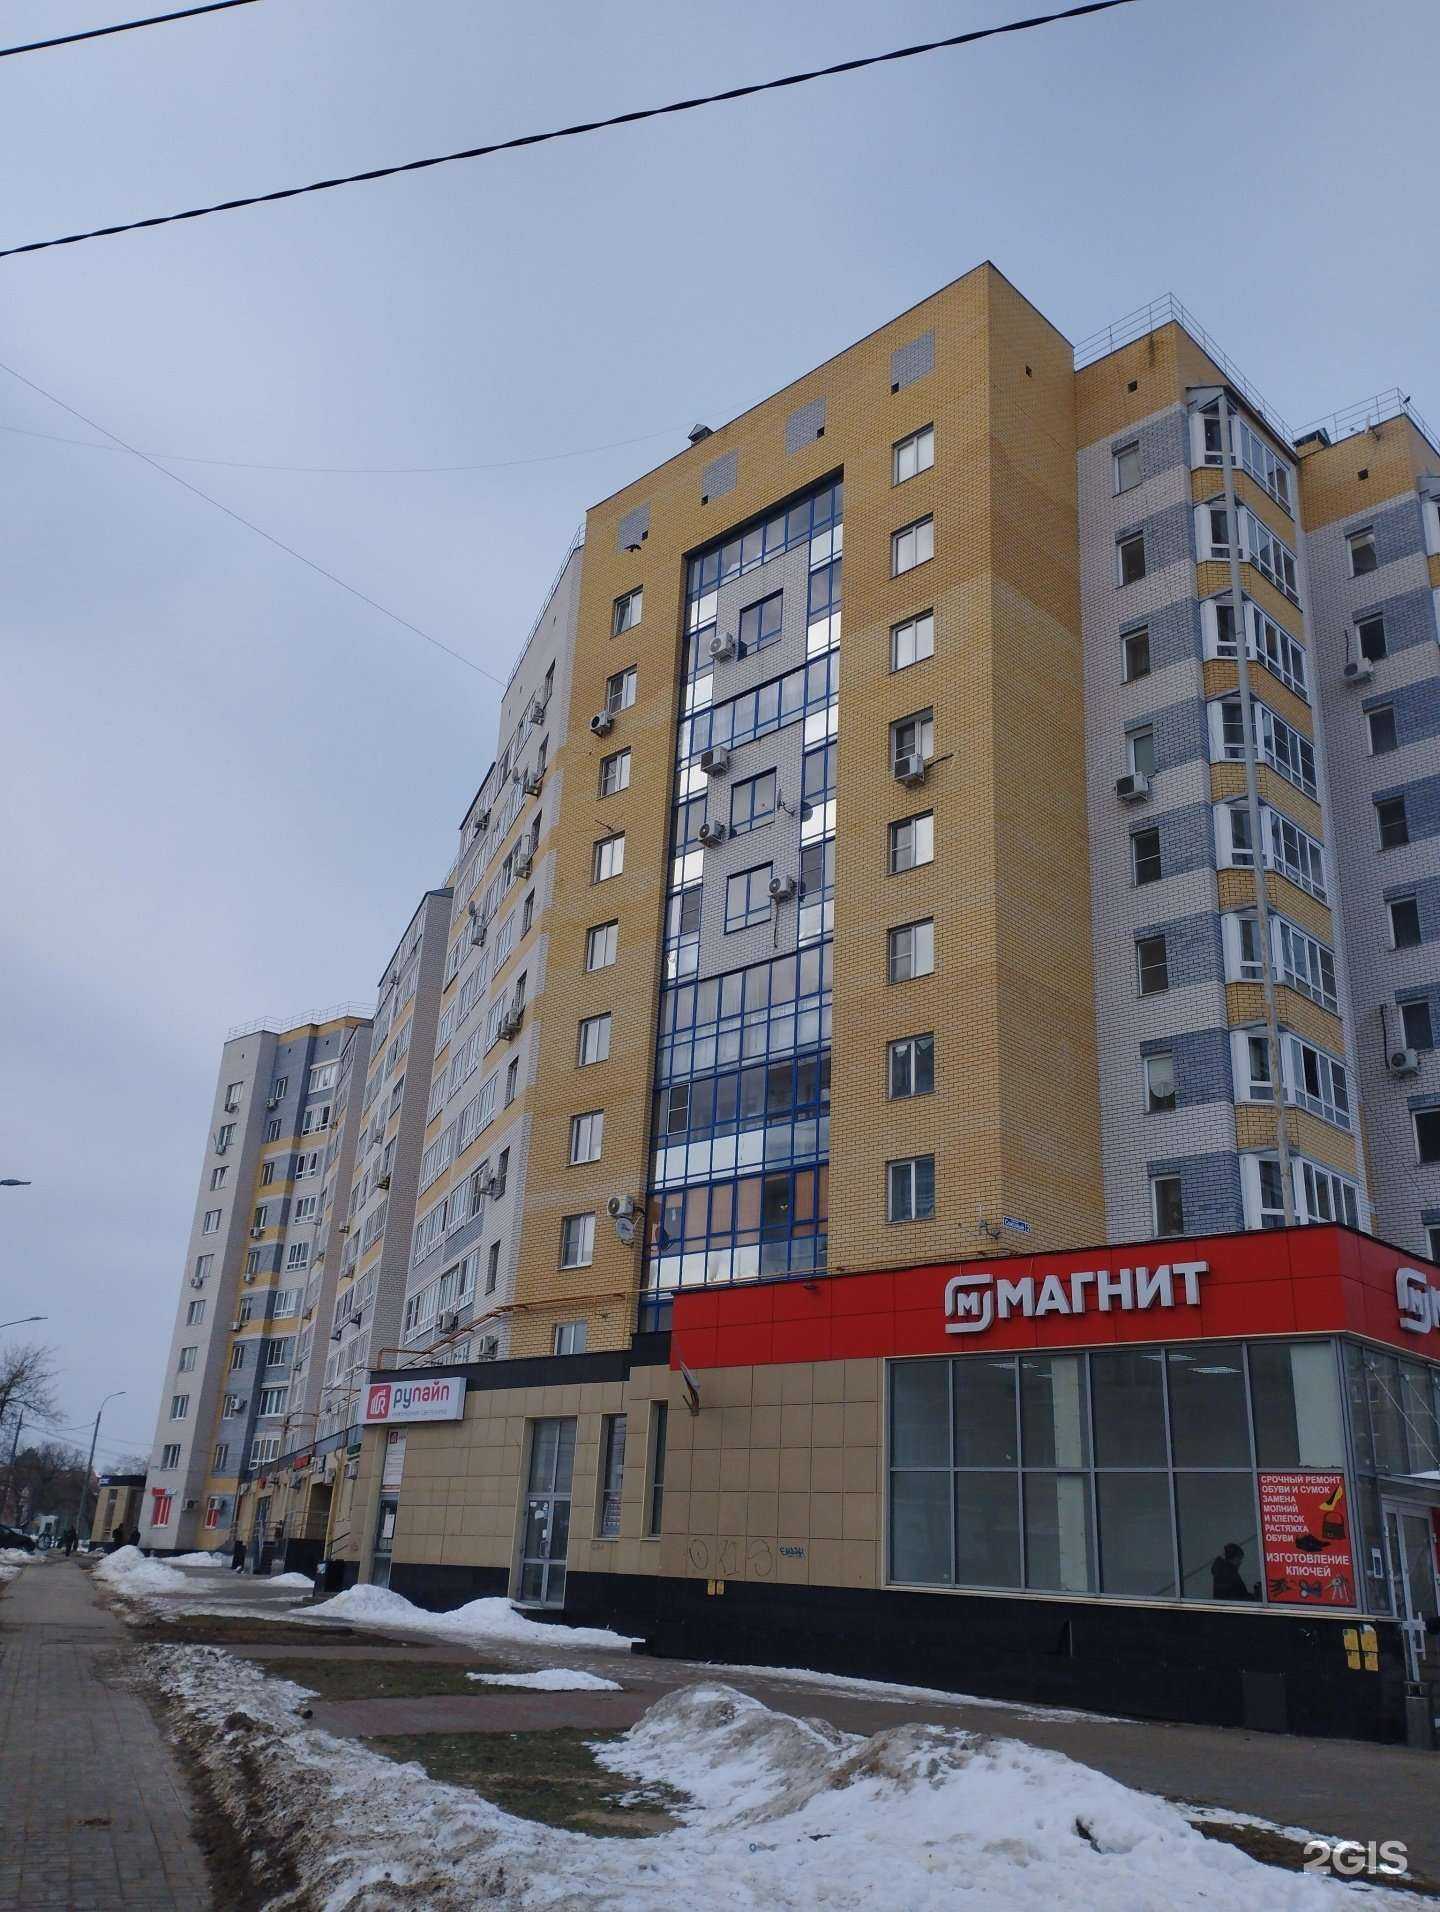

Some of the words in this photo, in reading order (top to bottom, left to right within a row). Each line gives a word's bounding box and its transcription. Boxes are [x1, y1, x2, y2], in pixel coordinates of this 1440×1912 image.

[997, 1261, 1209, 1318] МАГНИТ
[393, 1381, 450, 1409] рупайп
[1261, 1475, 1305, 1484] СРОЧНЫЙ
[1305, 1476, 1342, 1484] РЕМОНТ
[1262, 1485, 1291, 1493] ОБУВИ
[1300, 1486, 1331, 1494] СУМОК
[1262, 1495, 1296, 1503] ЗАМЕНА
[1263, 1504, 1299, 1513] МОЛНИЙ
[1265, 1524, 1309, 1533] РАСТЯЖКА
[1266, 1534, 1294, 1542] ОБУВИ
[1266, 1553, 1350, 1565] ИЗГОТОВЛЕНИЕ
[1286, 1565, 1331, 1577] КЛЮЧЕЙ
